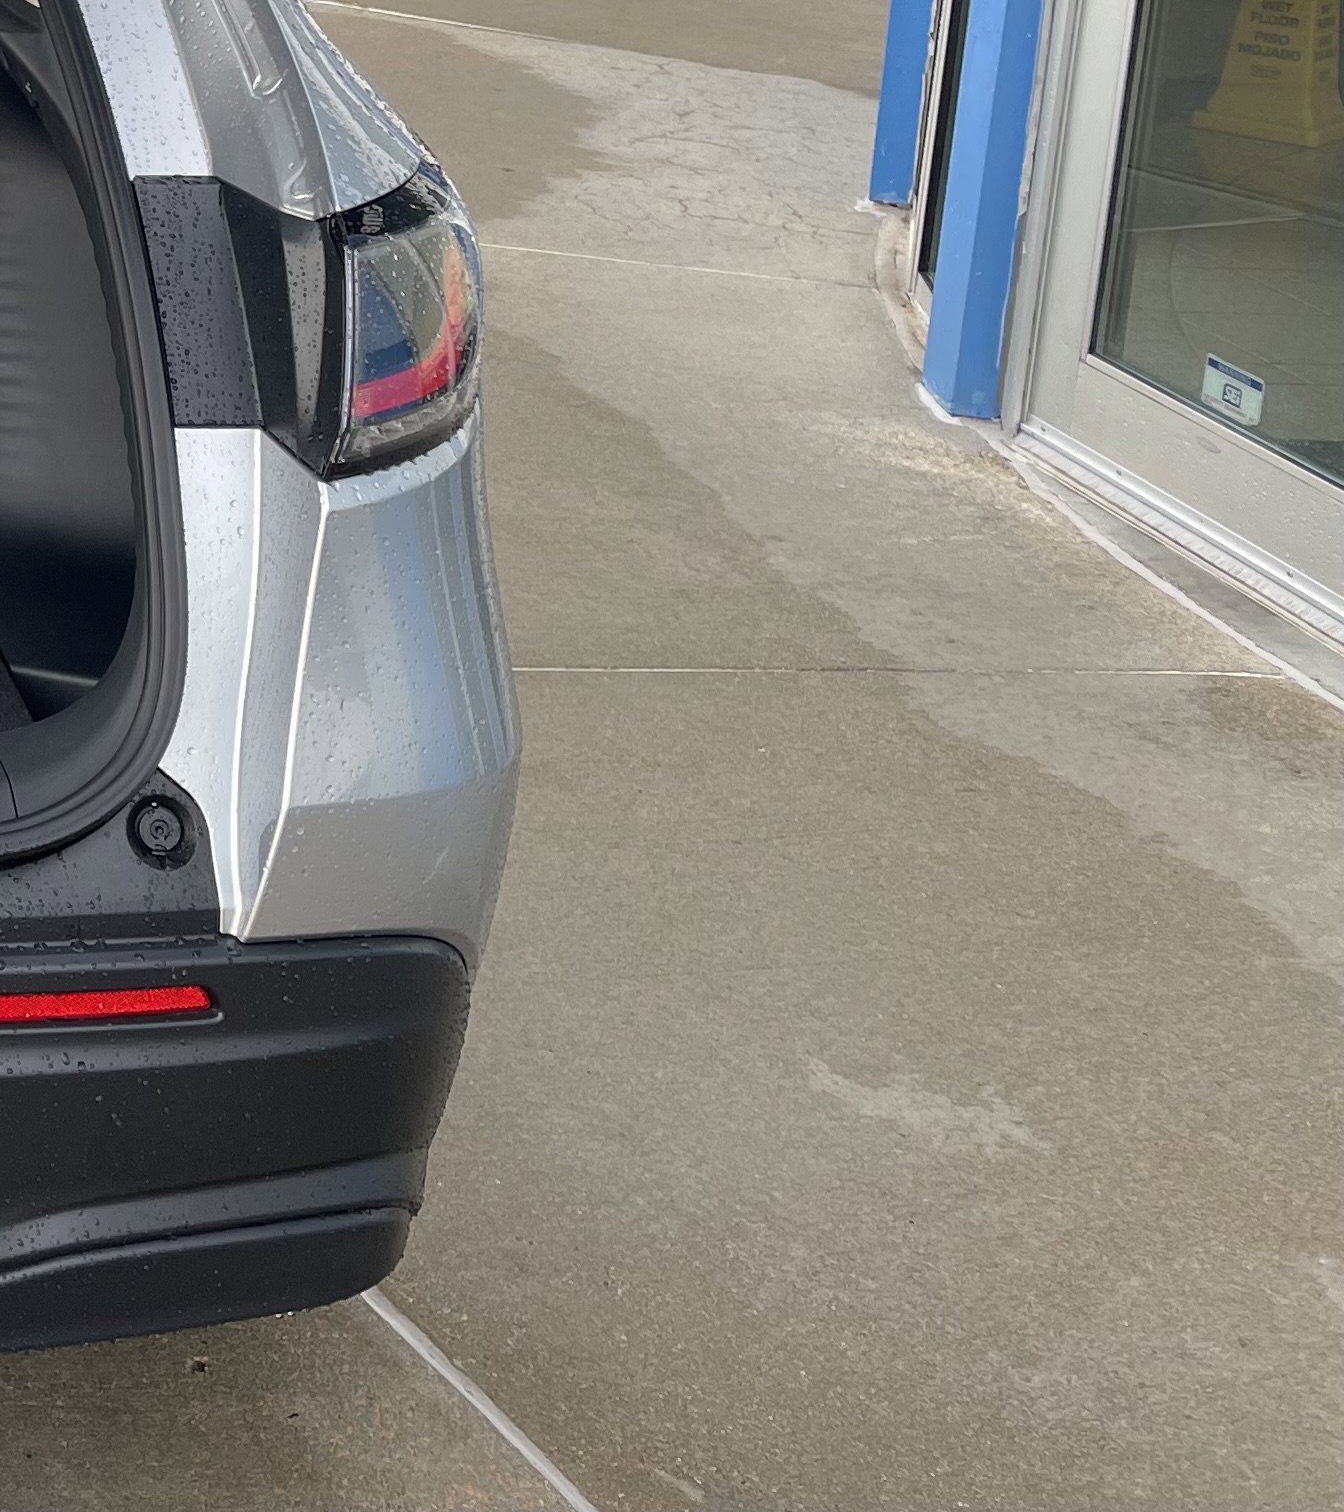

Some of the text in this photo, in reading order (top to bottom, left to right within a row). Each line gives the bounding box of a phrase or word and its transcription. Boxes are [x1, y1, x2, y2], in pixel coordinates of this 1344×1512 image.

[1261, 0, 1293, 13] WET
[1250, 11, 1300, 28] FLOOR
[1254, 31, 1289, 45] PISO
[1238, 42, 1301, 62] MOJADO
